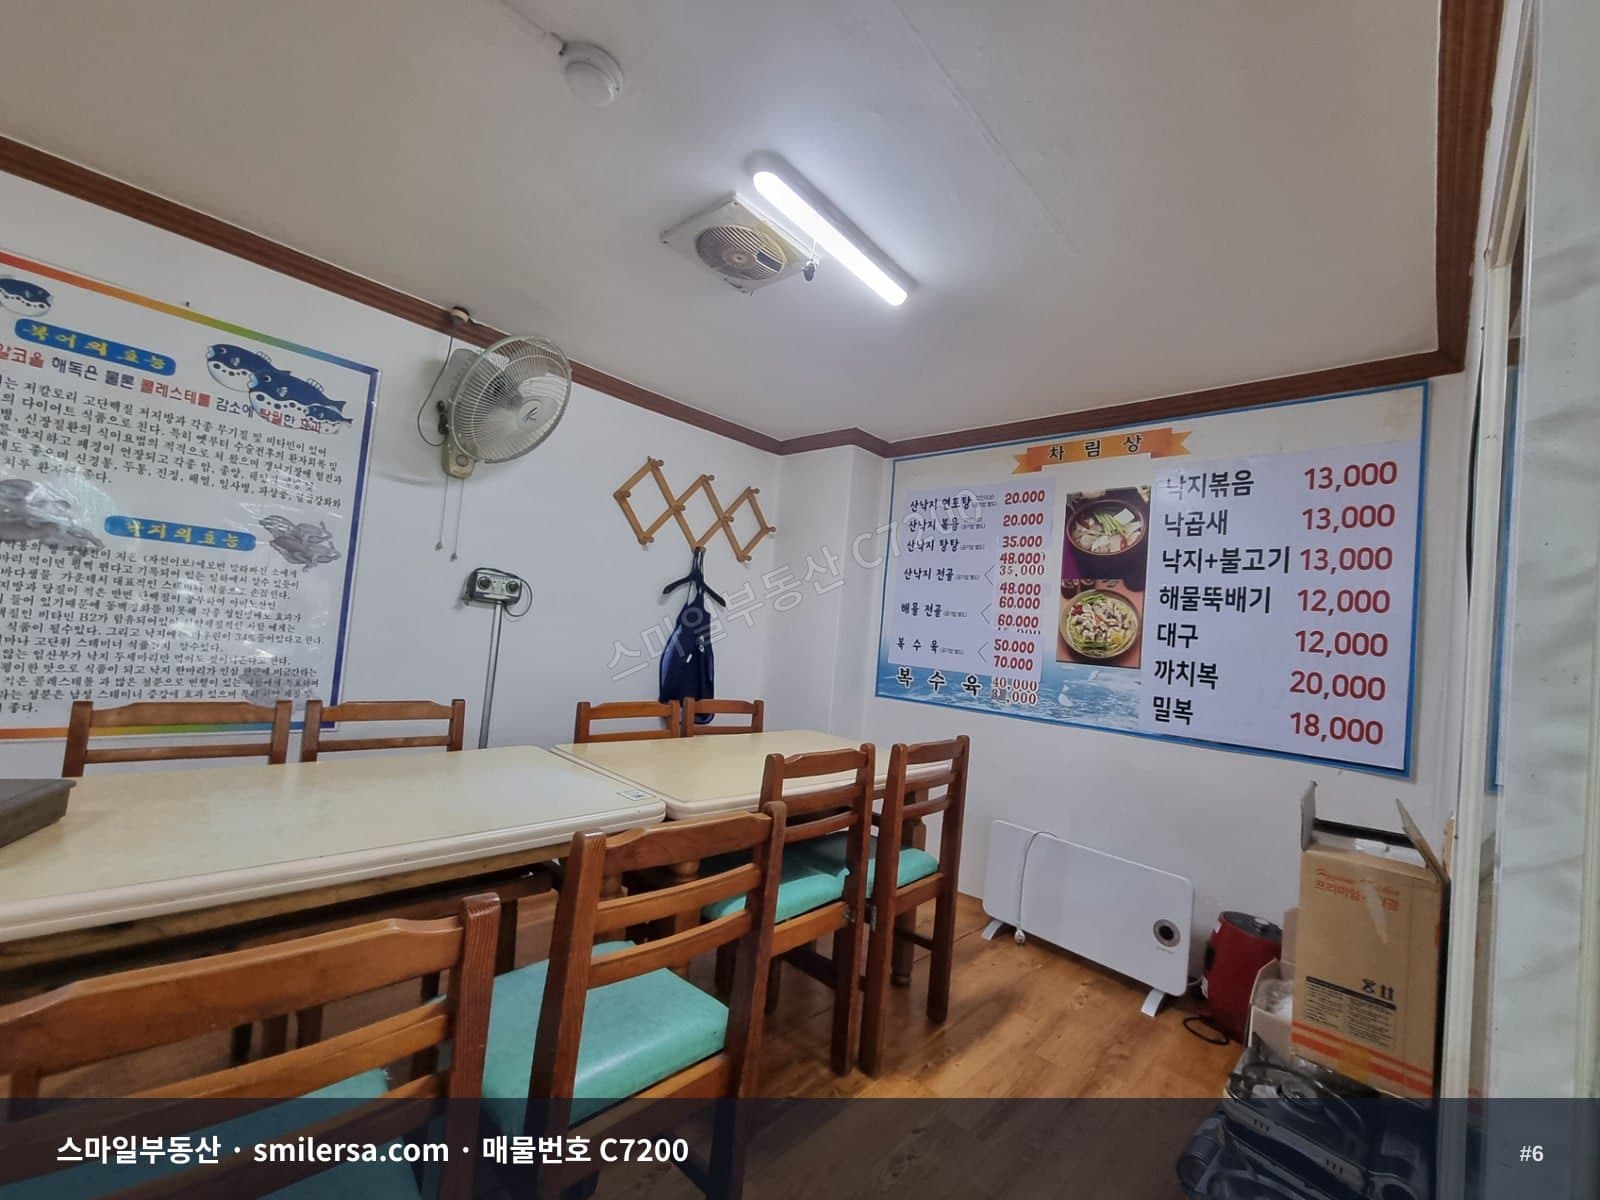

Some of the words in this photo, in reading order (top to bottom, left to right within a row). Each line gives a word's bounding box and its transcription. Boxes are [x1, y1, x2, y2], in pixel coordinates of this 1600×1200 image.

[1167, 469, 1255, 500] 낙지볶음
[1303, 461, 1398, 493] 13,000
[910, 498, 938, 513] 산낙지
[1004, 490, 1046, 505] 20.000
[908, 519, 937, 533] 산낙지
[1002, 513, 1045, 528] 20.000
[1164, 509, 1228, 538] 낙곱새
[1301, 504, 1396, 534] 13,000
[906, 539, 935, 553] 산낙지
[1002, 536, 1043, 549] 35.000
[999, 552, 1041, 565] 48.000
[1161, 546, 1290, 575] 낙지+불고기
[1300, 547, 1393, 576] 13,000
[904, 567, 932, 581] 산낙지
[999, 582, 1041, 596] 48.000
[1159, 585, 1271, 613] 해물뚝배기
[999, 596, 1041, 610] 60.000
[1297, 589, 1391, 617] 12,000
[997, 614, 1039, 629] 60.000
[994, 639, 1036, 654] 50.000
[1157, 622, 1199, 649] 대구
[1295, 630, 1388, 658] 12,000
[993, 656, 1034, 671] 70.000
[1154, 659, 1219, 690] 까치복
[1289, 671, 1386, 701] 20,000
[1153, 696, 1193, 726] 밀복
[1289, 712, 1384, 745] 18,000
